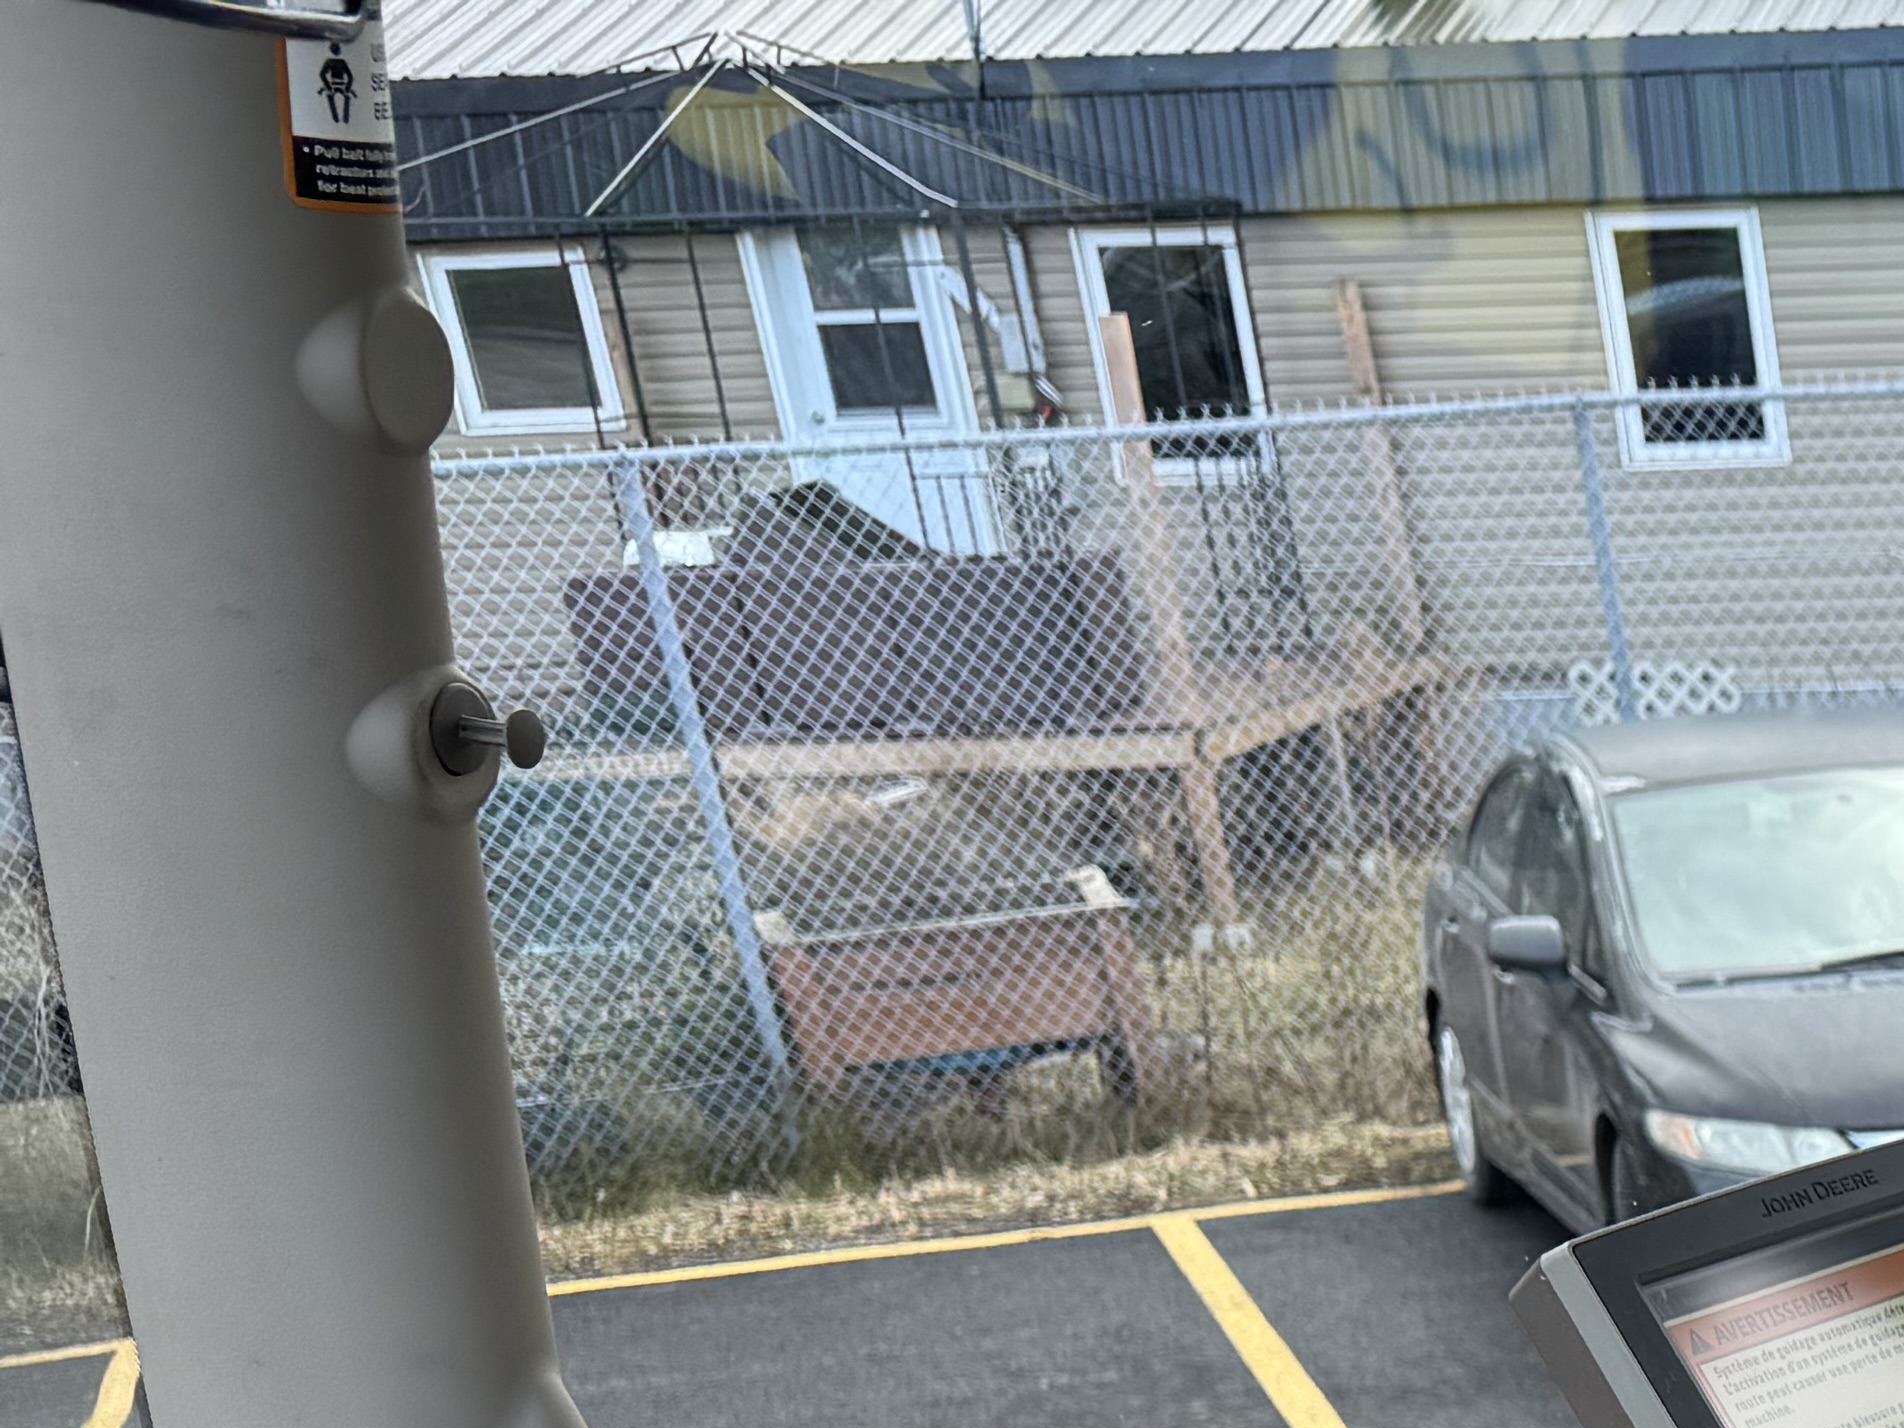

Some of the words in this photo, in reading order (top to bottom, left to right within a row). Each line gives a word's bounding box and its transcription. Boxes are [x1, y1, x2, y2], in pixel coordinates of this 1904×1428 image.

[1760, 1188, 1814, 1218] JOHN
[1811, 1169, 1879, 1200] DEERE
[1713, 1281, 1852, 1344] AVERTISSEMENT
[1761, 1350, 1775, 1362] de
[1776, 1336, 1816, 1359] guidage
[1854, 1337, 1867, 1348] de
[1878, 1348, 1892, 1359] de
